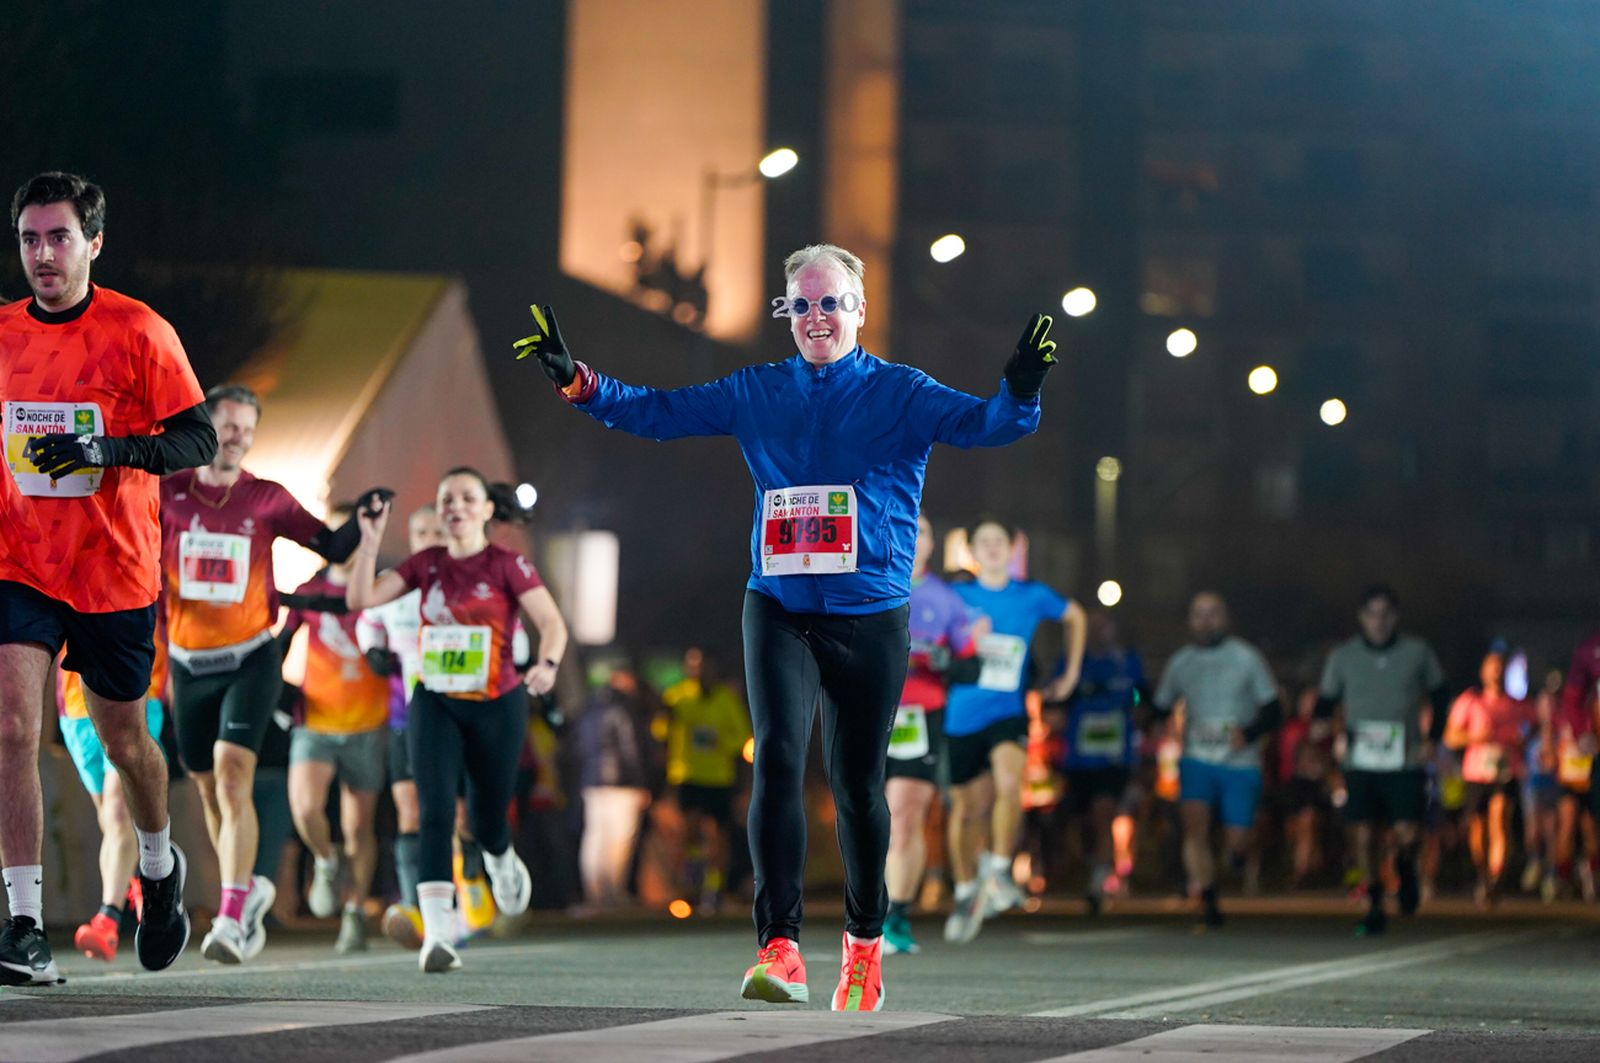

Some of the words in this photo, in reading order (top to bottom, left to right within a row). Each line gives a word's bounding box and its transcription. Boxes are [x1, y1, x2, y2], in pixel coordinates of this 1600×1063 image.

[27, 413, 52, 422] NOCHE
[54, 413, 65, 422] DE
[16, 424, 34, 434] SAN
[35, 423, 66, 434] ANTÓN
[809, 496, 819, 504] DE
[790, 506, 820, 517] ANTÓN
[779, 517, 837, 545] 9795
